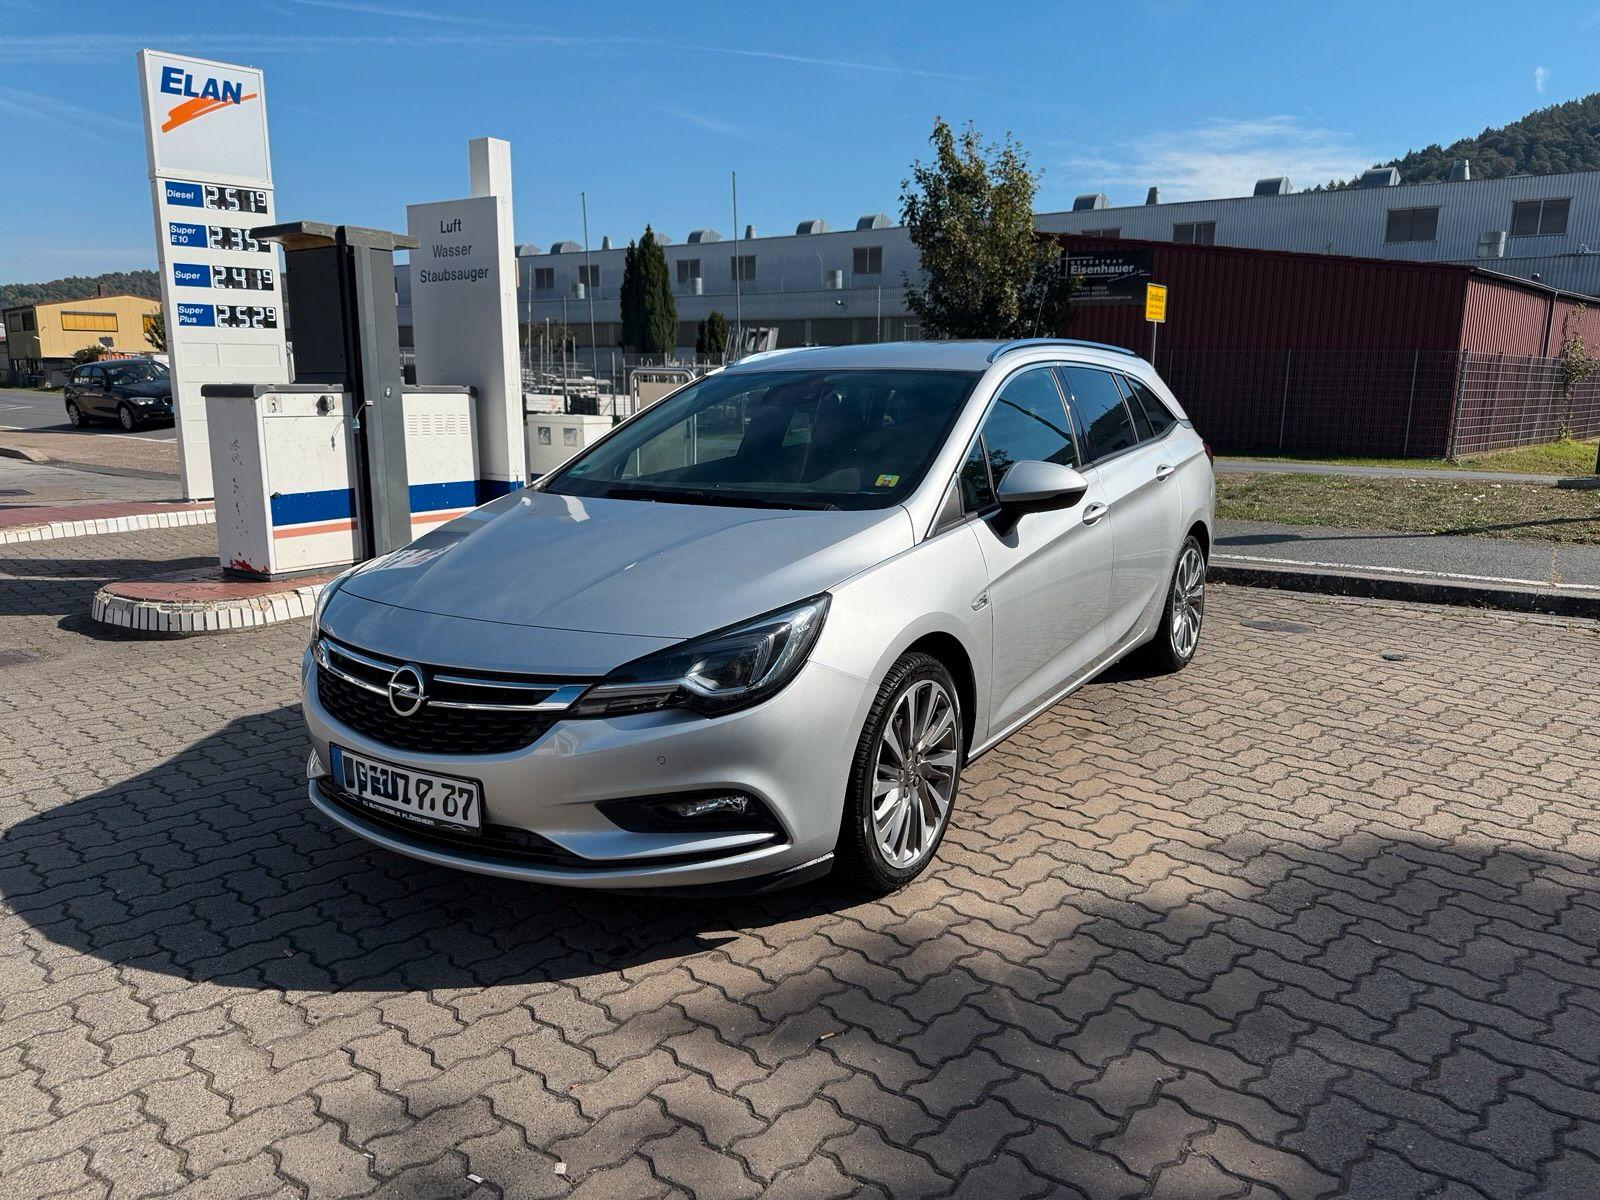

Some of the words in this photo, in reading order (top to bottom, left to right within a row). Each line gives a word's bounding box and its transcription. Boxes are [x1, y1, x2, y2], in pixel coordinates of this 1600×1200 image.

[161, 66, 242, 104] ELAN
[167, 189, 194, 199] Diesel
[170, 224, 196, 236] Super
[440, 219, 462, 233] Luft
[432, 244, 472, 258] Wasser
[175, 270, 200, 280] Super
[1070, 264, 1134, 275] Eisenhauer
[420, 268, 489, 283] Staubsauger
[179, 306, 204, 316] Super
[179, 315, 197, 323] Plus
